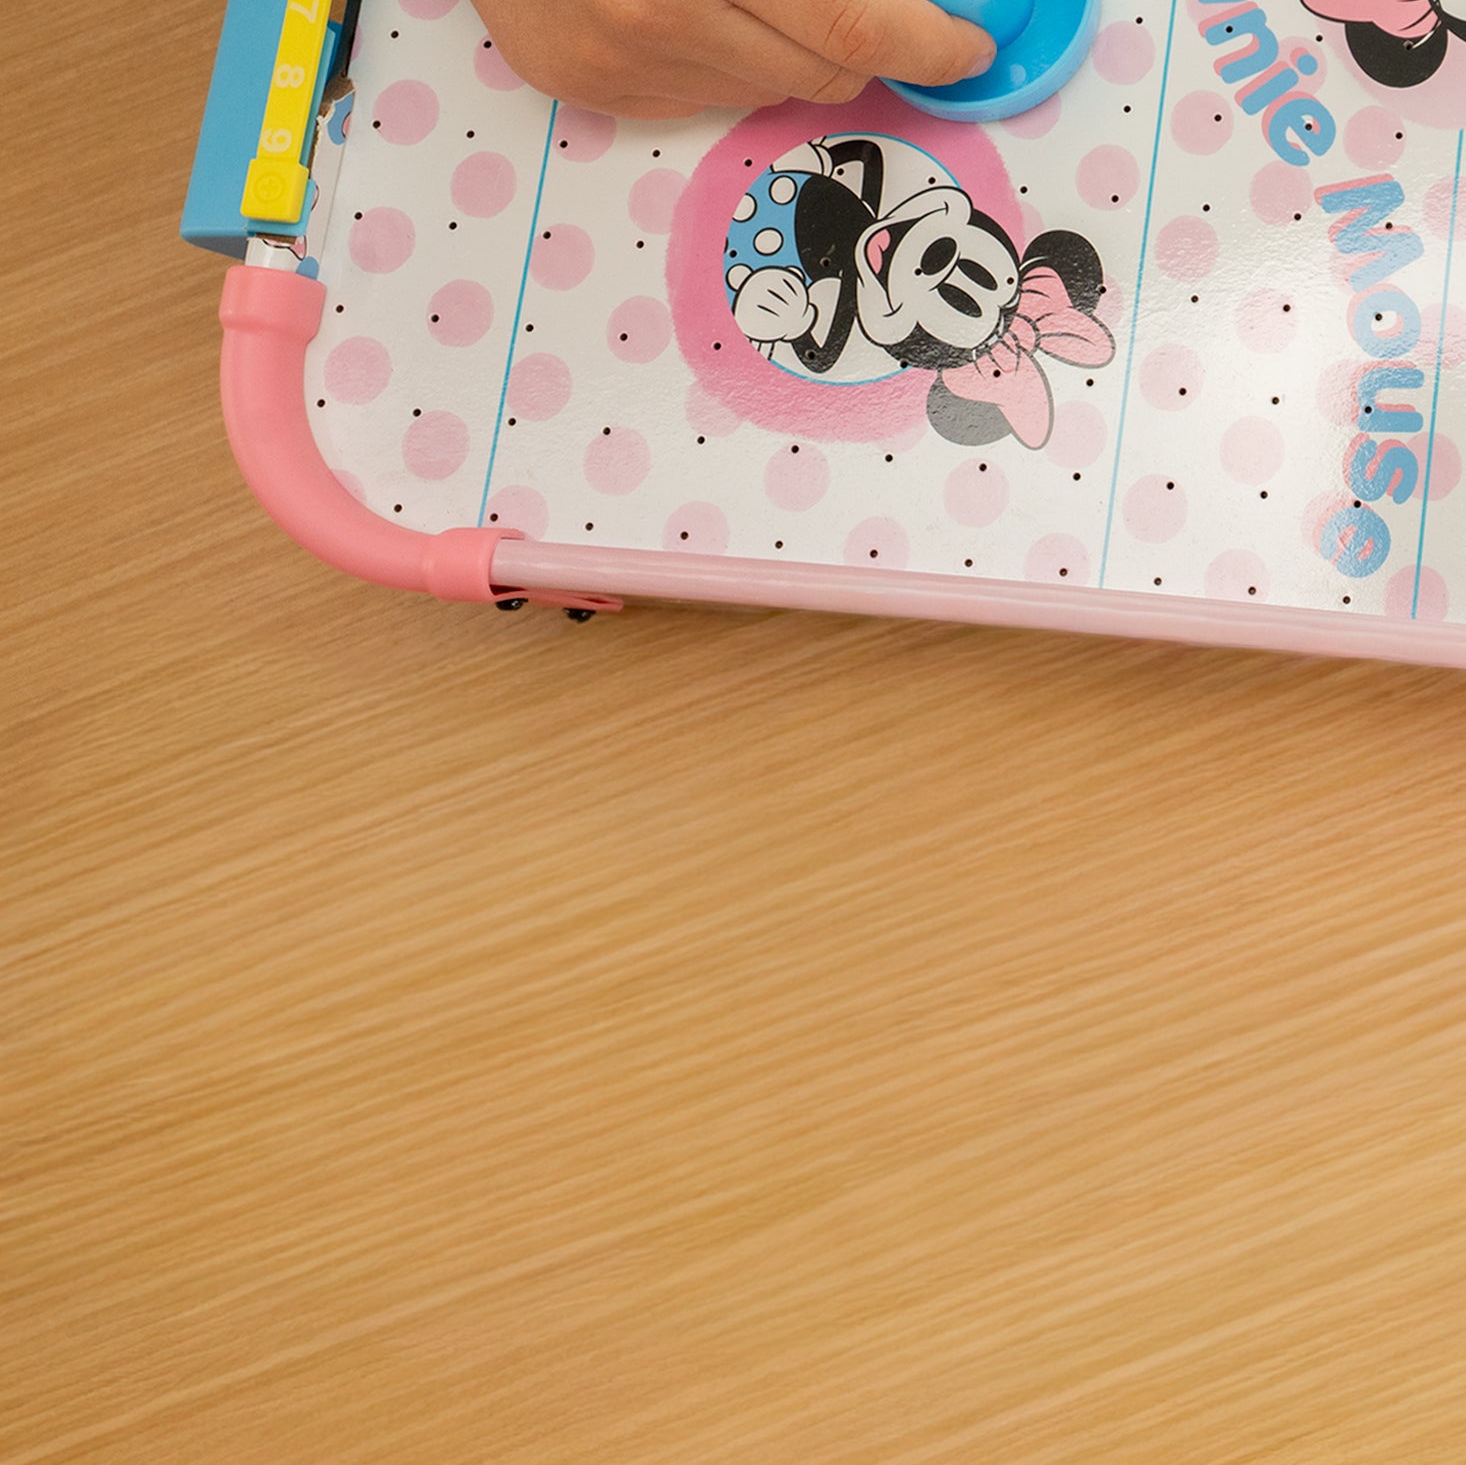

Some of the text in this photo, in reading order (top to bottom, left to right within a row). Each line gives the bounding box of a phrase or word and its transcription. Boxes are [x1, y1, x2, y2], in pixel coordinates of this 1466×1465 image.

[275, 64, 305, 89] 8
[261, 127, 292, 153] 9
[1314, 173, 1424, 578] Mouse
